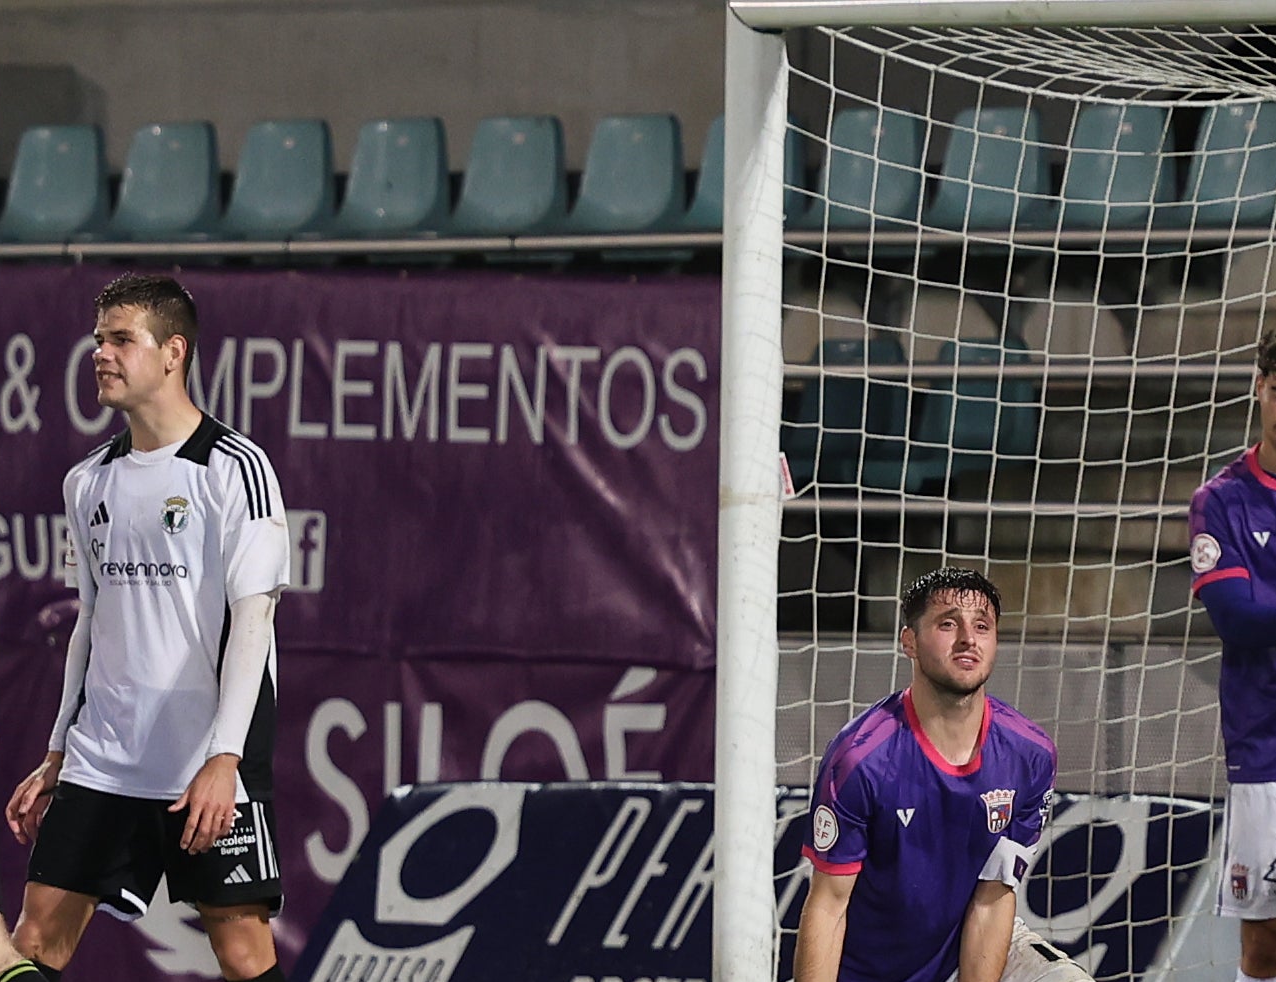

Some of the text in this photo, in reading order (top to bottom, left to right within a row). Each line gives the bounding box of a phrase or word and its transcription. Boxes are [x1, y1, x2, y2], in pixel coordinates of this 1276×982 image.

[0, 333, 42, 433] &
[65, 335, 708, 452] CMPLEMENTOS
[220, 845, 249, 856] Burgos
